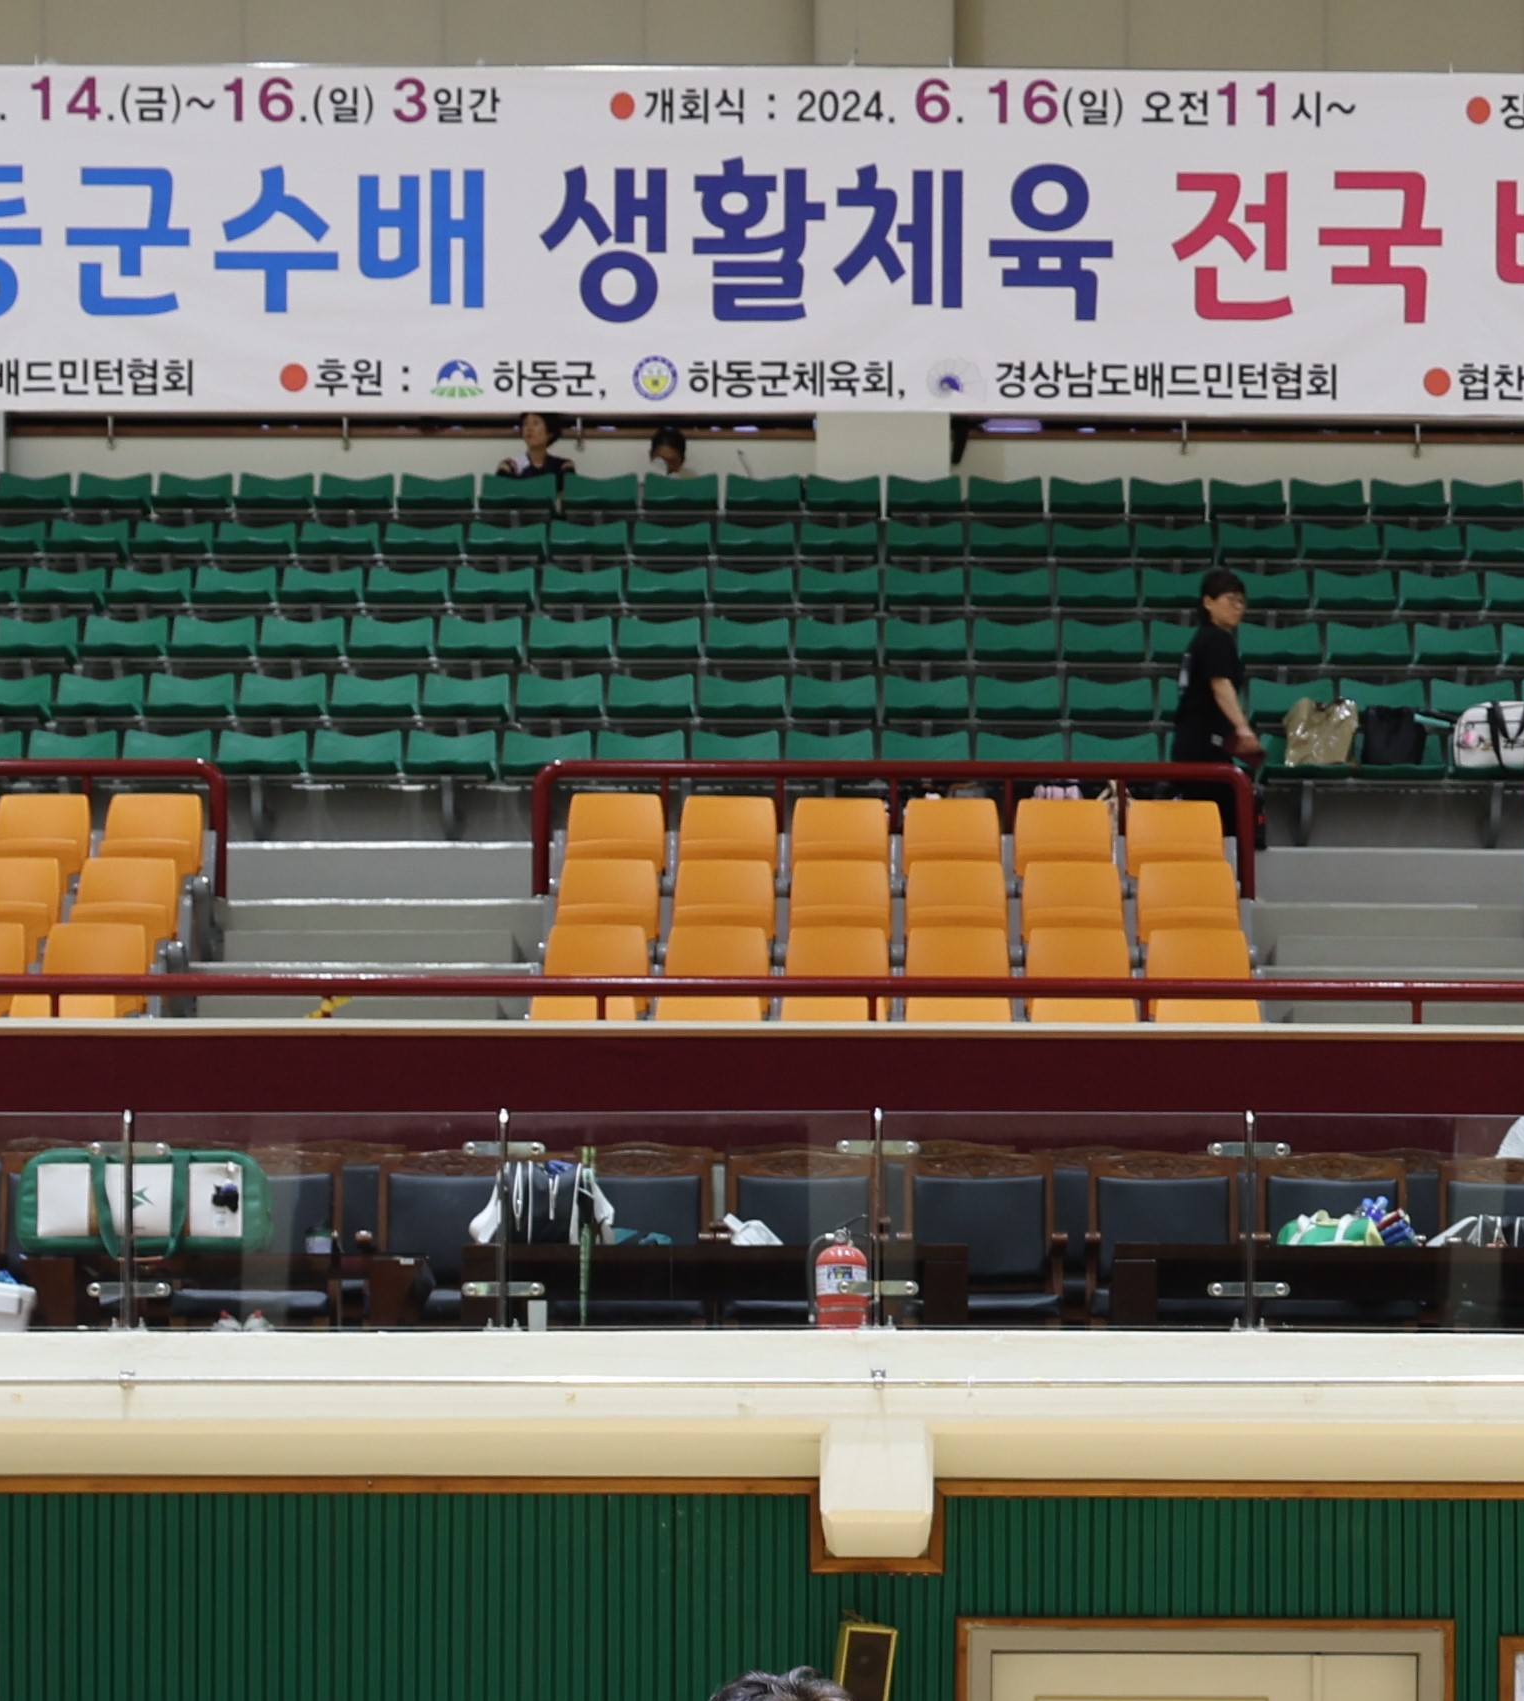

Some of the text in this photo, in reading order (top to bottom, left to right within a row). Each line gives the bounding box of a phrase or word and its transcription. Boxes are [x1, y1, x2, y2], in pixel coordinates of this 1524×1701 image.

[392, 76, 501, 124] 3일간
[644, 87, 745, 125] 개회식
[796, 88, 896, 125] 2024.
[914, 77, 964, 125] 6.
[987, 78, 1124, 128] 16(일)
[538, 155, 1114, 324] 생활체육
[1171, 170, 1444, 325] 전국
[314, 358, 383, 398] 후원
[492, 359, 607, 400] 하동군,
[687, 359, 906, 400] 하동군체육회,
[995, 359, 1338, 401] 경상남도배드민턴협회
